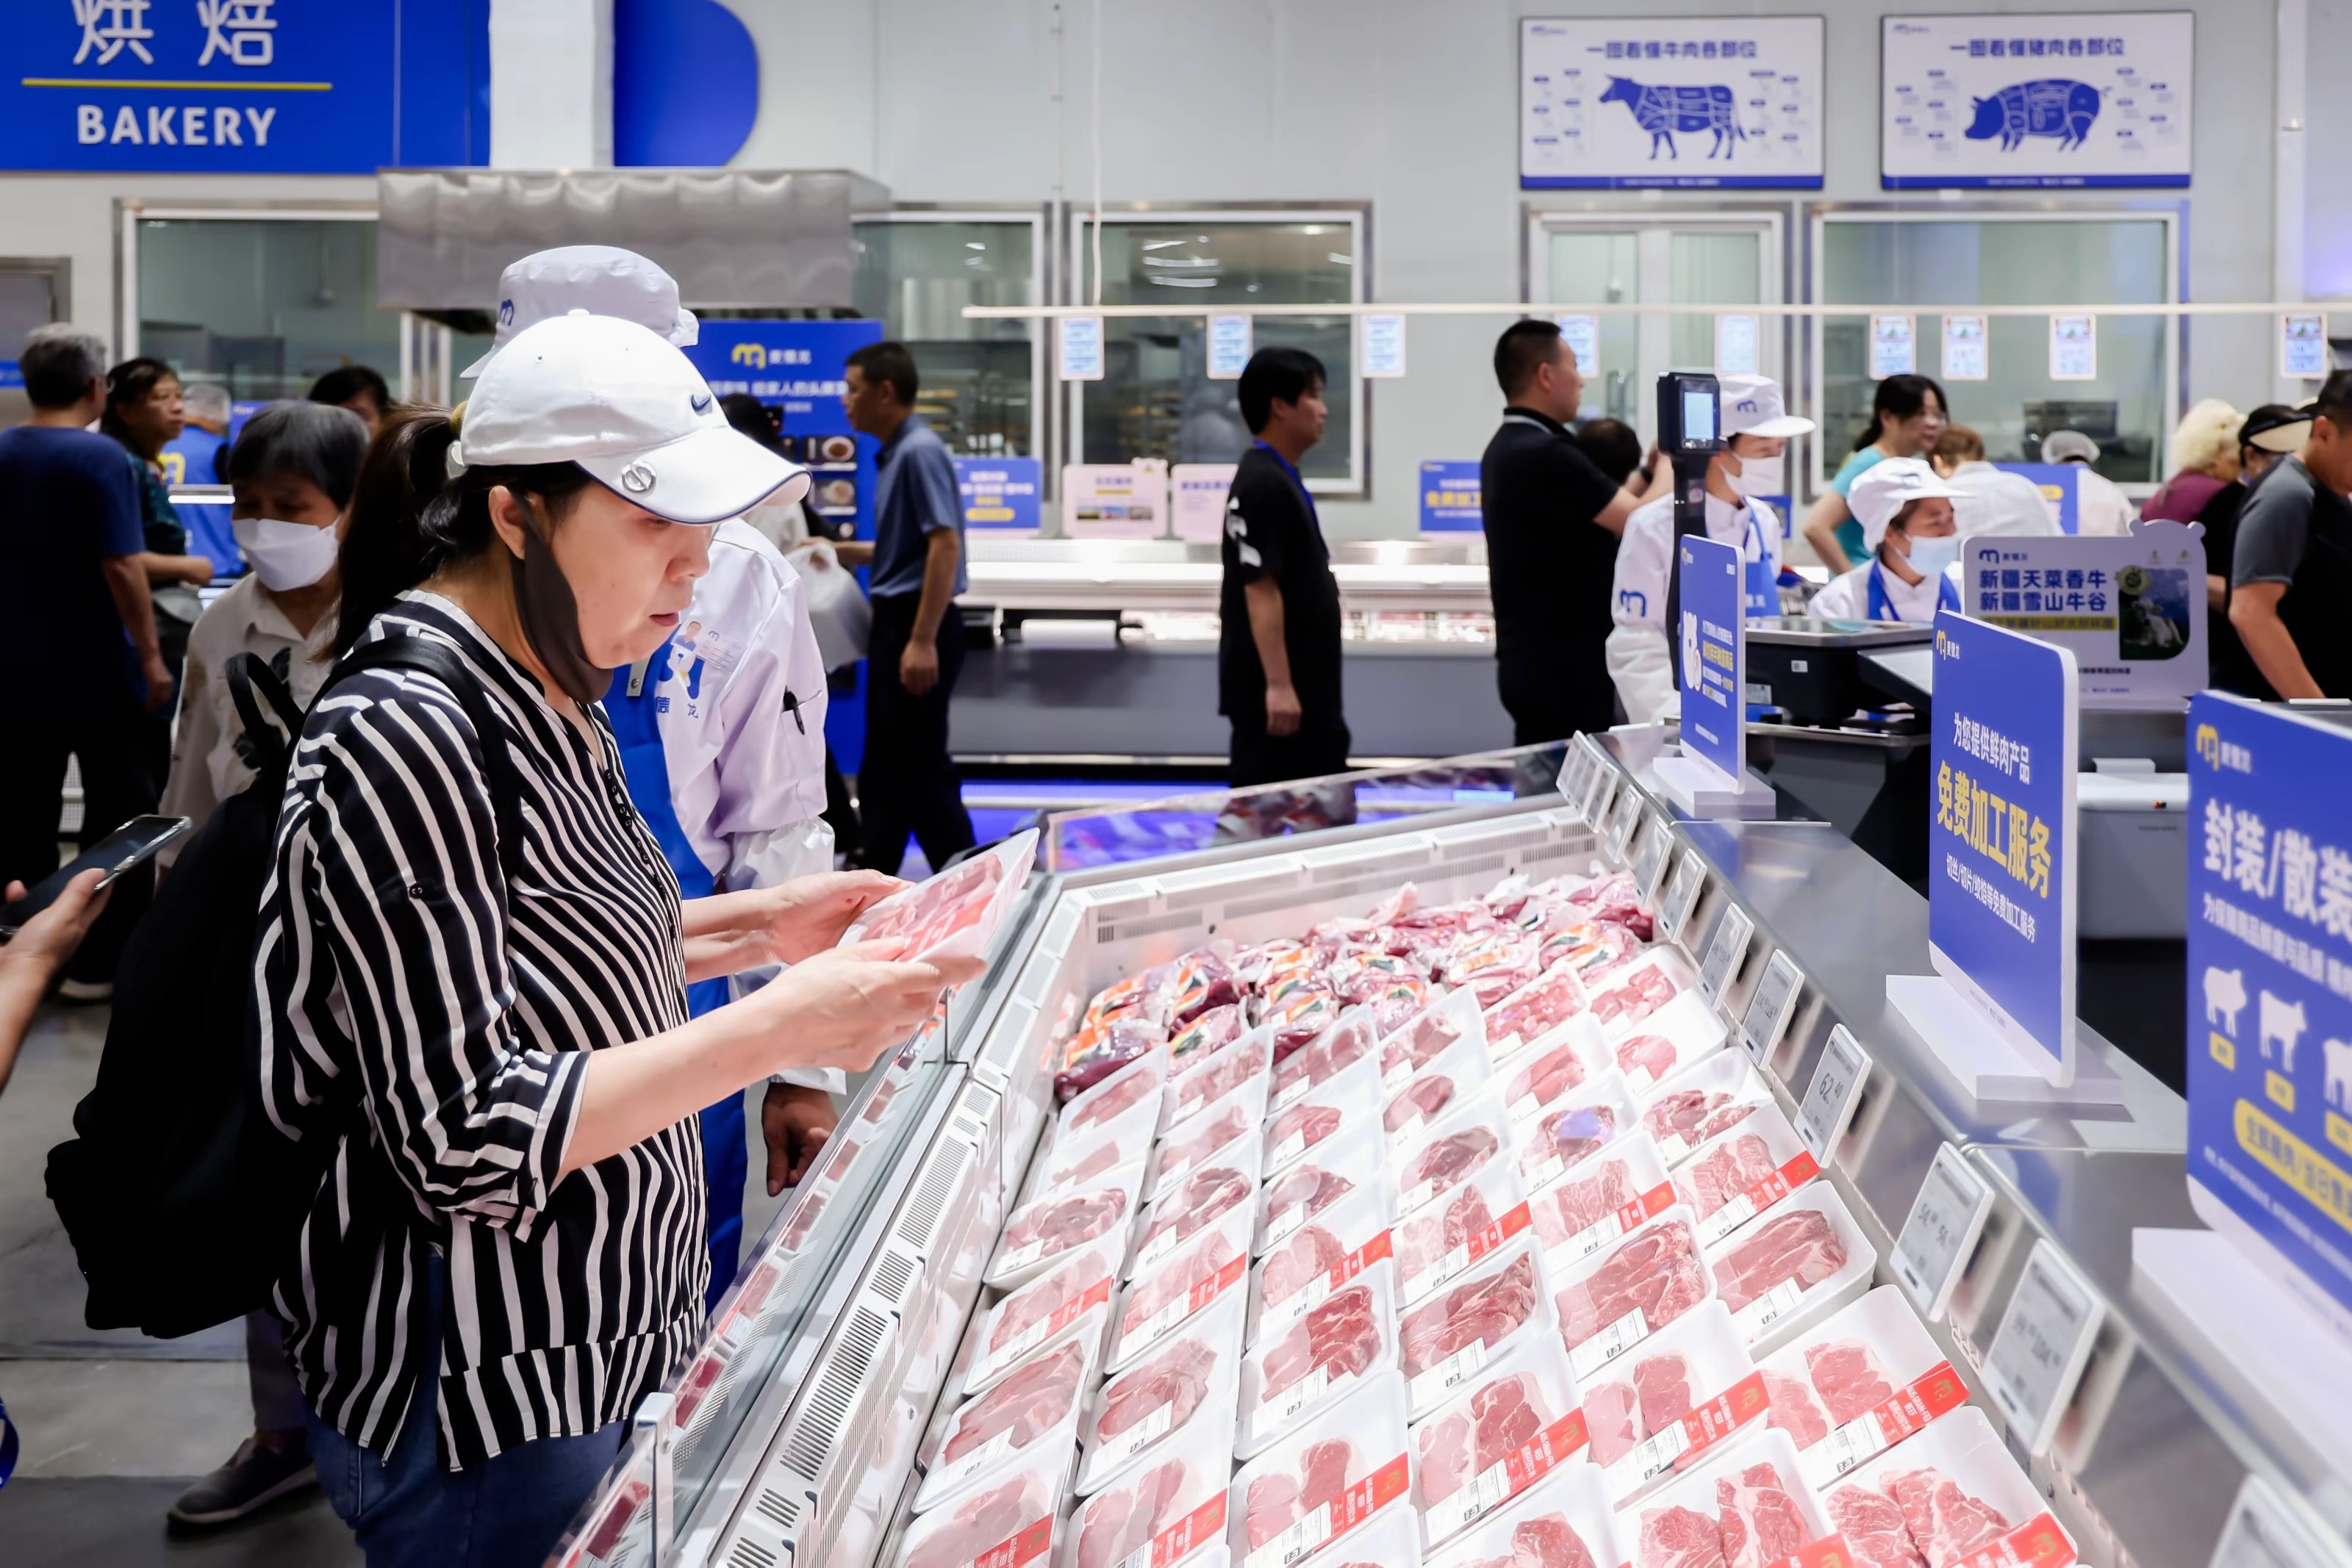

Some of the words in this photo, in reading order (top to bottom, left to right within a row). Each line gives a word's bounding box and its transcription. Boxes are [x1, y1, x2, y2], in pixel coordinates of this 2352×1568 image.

[73, 0, 278, 66] 烘焙
[76, 105, 276, 148] BAKERY
[1979, 569, 2107, 589] 新疆天菜香牛
[1980, 591, 2107, 611] 新疆雪山牛谷
[1954, 711, 2030, 785] 为您提供鲜肉产品
[1937, 759, 2051, 899] 免费加工服务
[2204, 796, 2352, 947] 封装/散装
[1904, 1402, 1918, 1417] BEEF
